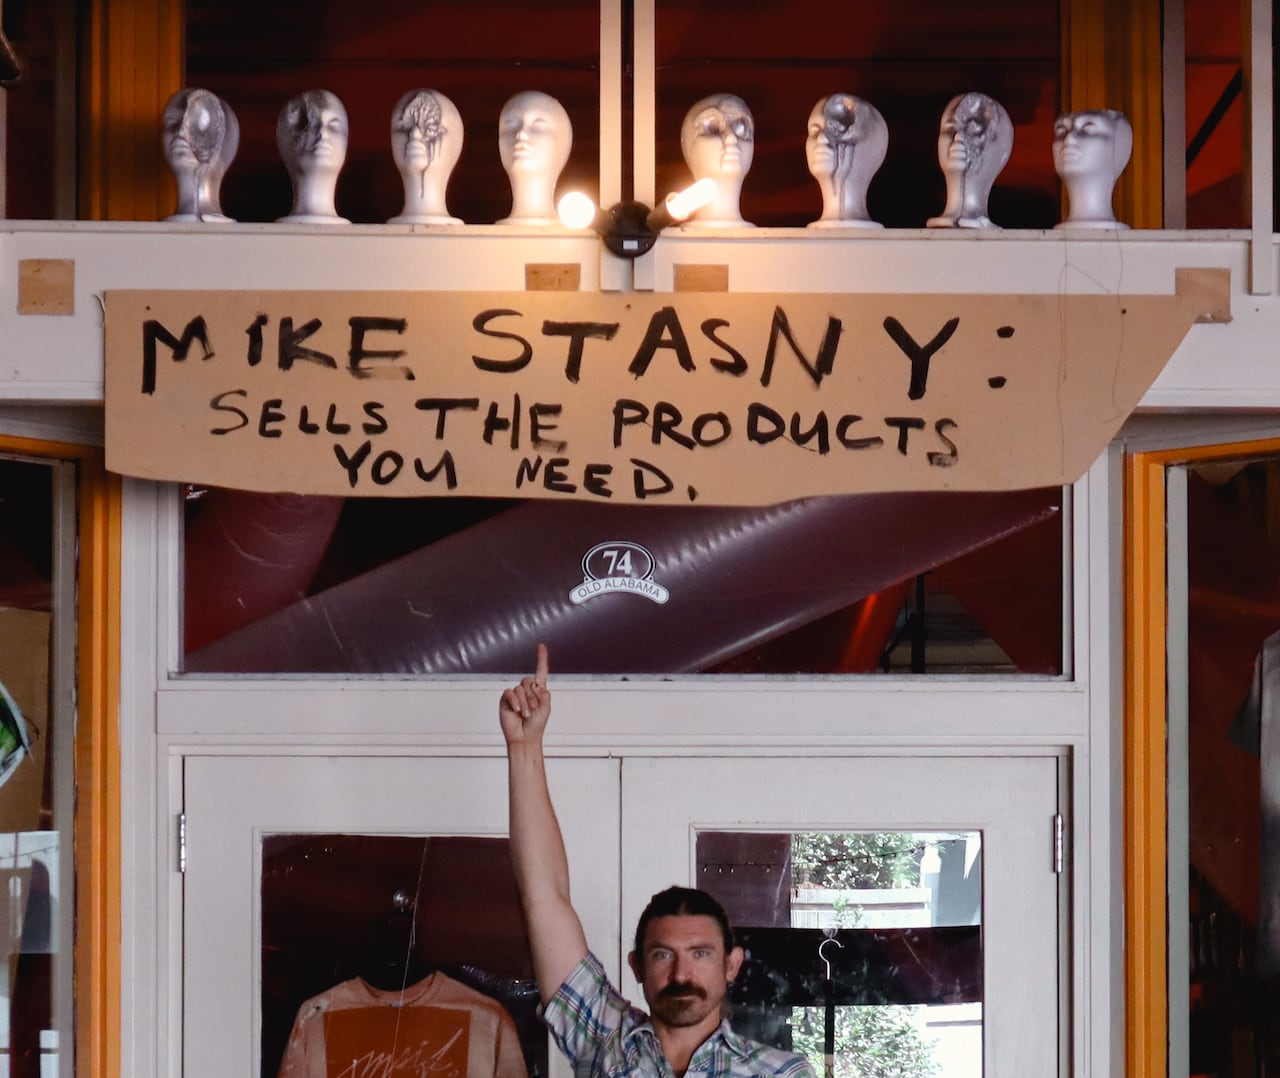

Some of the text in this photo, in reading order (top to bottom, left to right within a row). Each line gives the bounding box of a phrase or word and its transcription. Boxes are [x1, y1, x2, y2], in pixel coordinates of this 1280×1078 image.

[141, 314, 416, 395] MIKE
[210, 389, 959, 467] SELLS THE PRODUCTS
[333, 440, 699, 501] YOU NEED.
[577, 579, 660, 598] OLD ALABAMA
[602, 550, 633, 575] 74
